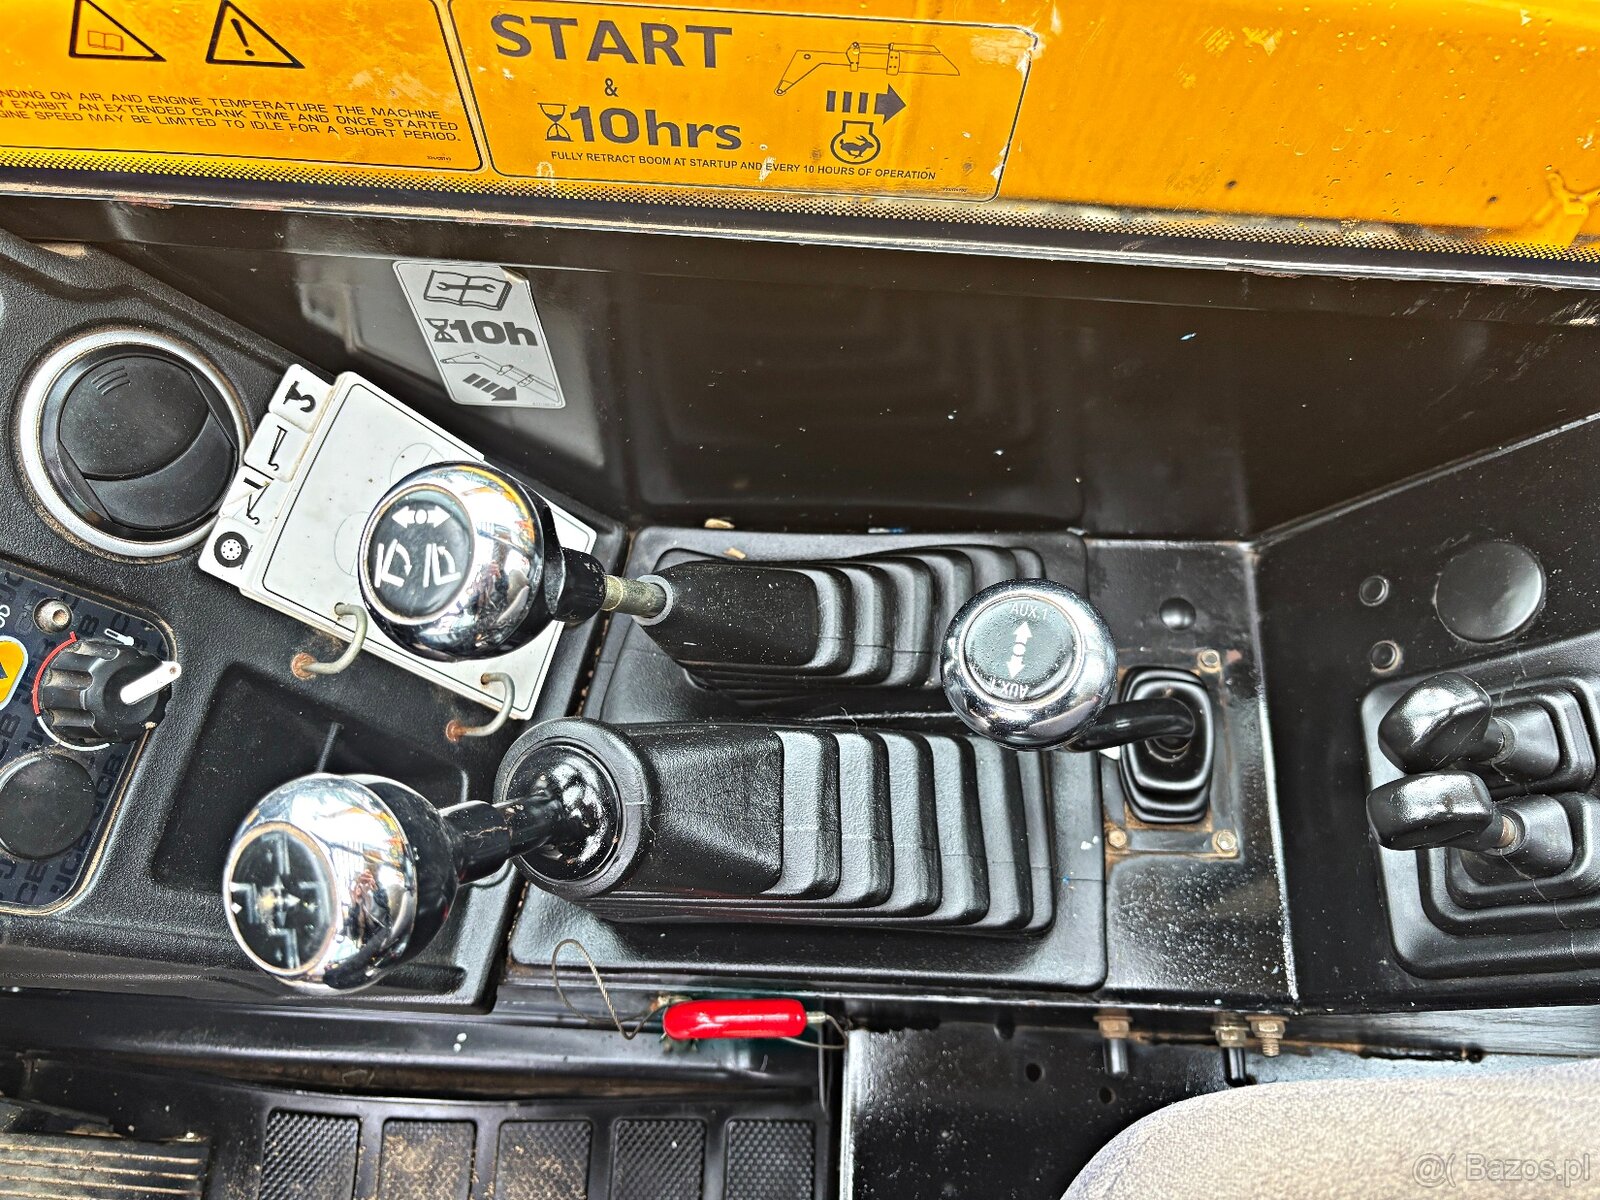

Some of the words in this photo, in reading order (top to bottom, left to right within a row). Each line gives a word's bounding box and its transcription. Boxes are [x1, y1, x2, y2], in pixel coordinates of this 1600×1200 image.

[490, 12, 732, 69] START
[604, 78, 618, 98] &
[11, 100, 67, 110] EXHIBIT
[79, 103, 99, 111] AN
[104, 103, 186, 115] EXTENDED
[192, 108, 247, 118] CRANK
[252, 111, 291, 121] TIME
[299, 113, 330, 123] AND
[336, 116, 377, 126] ONCE
[383, 119, 458, 130] STARTED
[50, 91, 72, 100] ON
[80, 92, 104, 101] AIR
[112, 94, 142, 103] AND
[148, 95, 203, 106] ENGINE
[208, 98, 328, 113] TEMPERATURE
[333, 105, 366, 115] THE
[371, 107, 441, 119] MACHINE
[35, 112, 83, 121] SPEED
[89, 114, 124, 123] MAY
[131, 115, 152, 124] BE
[156, 116, 216, 127] LIMITED
[222, 119, 244, 128] TO
[250, 121, 284, 130] IDLE
[289, 123, 320, 133] FOR
[327, 126, 339, 134] A
[344, 127, 396, 137] SHORT
[404, 130, 461, 141] PERIOD.
[570, 105, 742, 150] 10hrs
[551, 151, 583, 160] FULLY
[587, 153, 635, 163] RETRACT
[639, 156, 671, 165] BOOM
[674, 158, 686, 166] AT
[690, 159, 737, 169] STARTUP
[741, 162, 762, 171] AND
[765, 163, 800, 172] EVERY
[804, 165, 815, 173] 10
[818, 166, 854, 175] HOURS
[858, 168, 871, 176] OF
[875, 169, 936, 180] OPERATION
[449, 320, 538, 346] 10h
[1010, 603, 1048, 620] AUX.1
